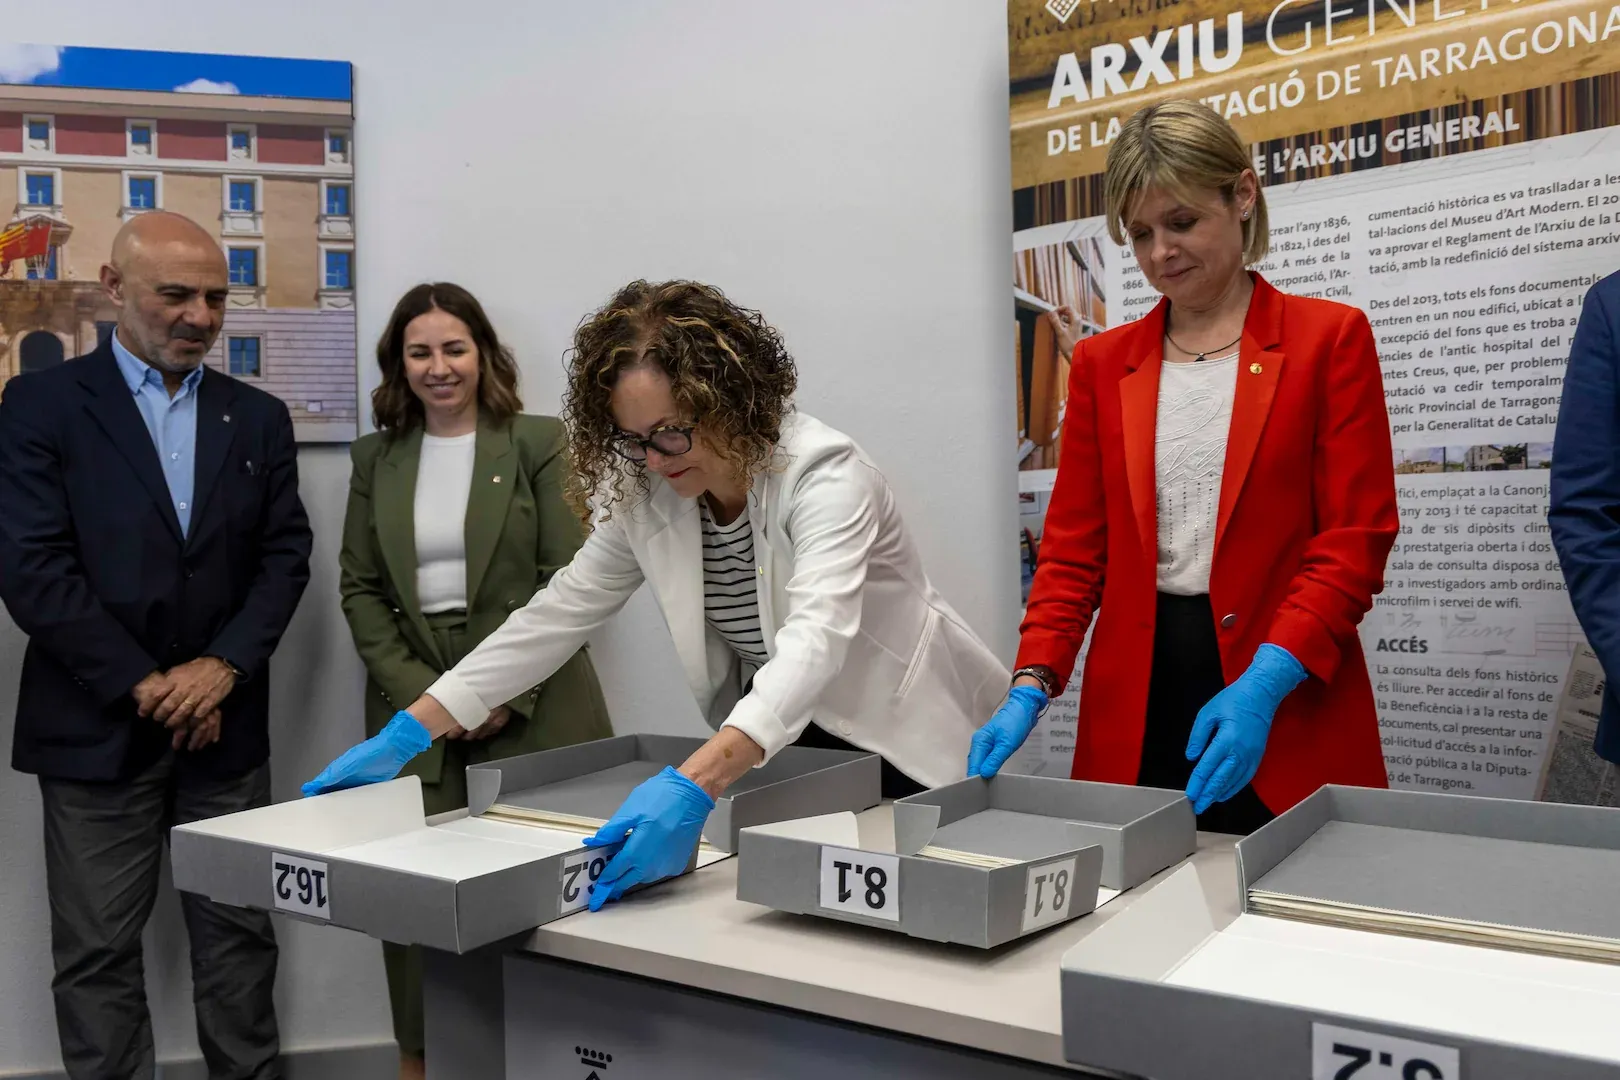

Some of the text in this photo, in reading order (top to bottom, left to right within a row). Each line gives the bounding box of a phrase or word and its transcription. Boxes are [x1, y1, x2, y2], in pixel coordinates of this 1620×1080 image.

[1047, 10, 1244, 109] ARXIU
[1047, 5, 1620, 156] DE LA TACIÓ DE TARRAGONA
[1384, 108, 1520, 153] GENERAL
[1368, 177, 1601, 221] cumentació històrica es va traslladar a
[1323, 215, 1351, 228] 1836,
[1429, 218, 1448, 230] del
[1451, 213, 1492, 227] Museu
[1529, 201, 1584, 216] Modern.
[1587, 195, 1599, 207] El
[1280, 232, 1350, 252] 1822, des del
[1368, 248, 1382, 256] va
[1384, 241, 1429, 256] aprovar
[1431, 236, 1442, 248] el
[1446, 228, 1511, 248] Reglament
[1515, 225, 1531, 236] de
[1534, 219, 1575, 234] l'Arxiu
[1578, 216, 1595, 228] de
[1599, 213, 1611, 225] la
[1121, 250, 1131, 259] La
[1282, 250, 1350, 268] A més de la
[1369, 261, 1400, 275] tació,
[1402, 257, 1428, 271] amb
[1430, 256, 1441, 267] la
[1444, 246, 1508, 265] redefinició
[1511, 243, 1531, 256] del
[1533, 238, 1584, 253] sistema
[1122, 279, 1144, 290] 1866
[1269, 271, 1327, 288] corporació,
[1325, 285, 1352, 298] Civil,
[1370, 273, 1602, 310] Des del 2013, tots els fons documentals
[1370, 297, 1562, 327] centren en un nou edifici, ubicat
[1380, 317, 1565, 345] excepció del fons que es troba
[1419, 348, 1433, 359] de
[1483, 338, 1533, 354] hospital
[1540, 335, 1560, 348] del
[1413, 367, 1449, 377] Creus,
[1454, 364, 1480, 377] que,
[1485, 362, 1505, 374] per
[1433, 385, 1446, 394] va
[1454, 380, 1483, 393] cedir
[1388, 396, 1563, 415] tòric Provincial de Tarragona
[1393, 424, 1412, 436] per
[1414, 421, 1424, 431] la
[1427, 417, 1494, 431] Generalitat
[1497, 416, 1513, 427] de
[1420, 485, 1500, 500] emplaçat la
[1425, 507, 1451, 518] 2013
[1464, 504, 1476, 515] té
[1480, 503, 1538, 518] capacitat
[1421, 522, 1515, 536] de sis dipòsits
[1403, 541, 1551, 556] prestatgeria oberta dos
[1391, 560, 1560, 574] sala de consulta disposa de
[1408, 578, 1518, 592] investigadors amb
[1375, 595, 1492, 608] microfilm servei de
[1376, 635, 1429, 654] ACCÉS
[1377, 664, 1558, 684] La consulta dels fons històrics
[1377, 681, 1553, 703] és lliure. Per accedir al fons de
[1377, 699, 1548, 722] la Beneficència la resta de
[1378, 717, 1542, 740] documents, cal presentar una
[1489, 744, 1500, 755] la
[1503, 745, 1538, 758] infor-
[1415, 757, 1458, 770] pública
[1471, 761, 1482, 772] la
[1486, 762, 1532, 777] Diputa-
[1397, 773, 1475, 790] de Tarragona.
[275, 862, 327, 908] 16.2
[563, 854, 615, 903] 6.2
[833, 860, 888, 910] 8.1
[1034, 869, 1068, 918] 8.1
